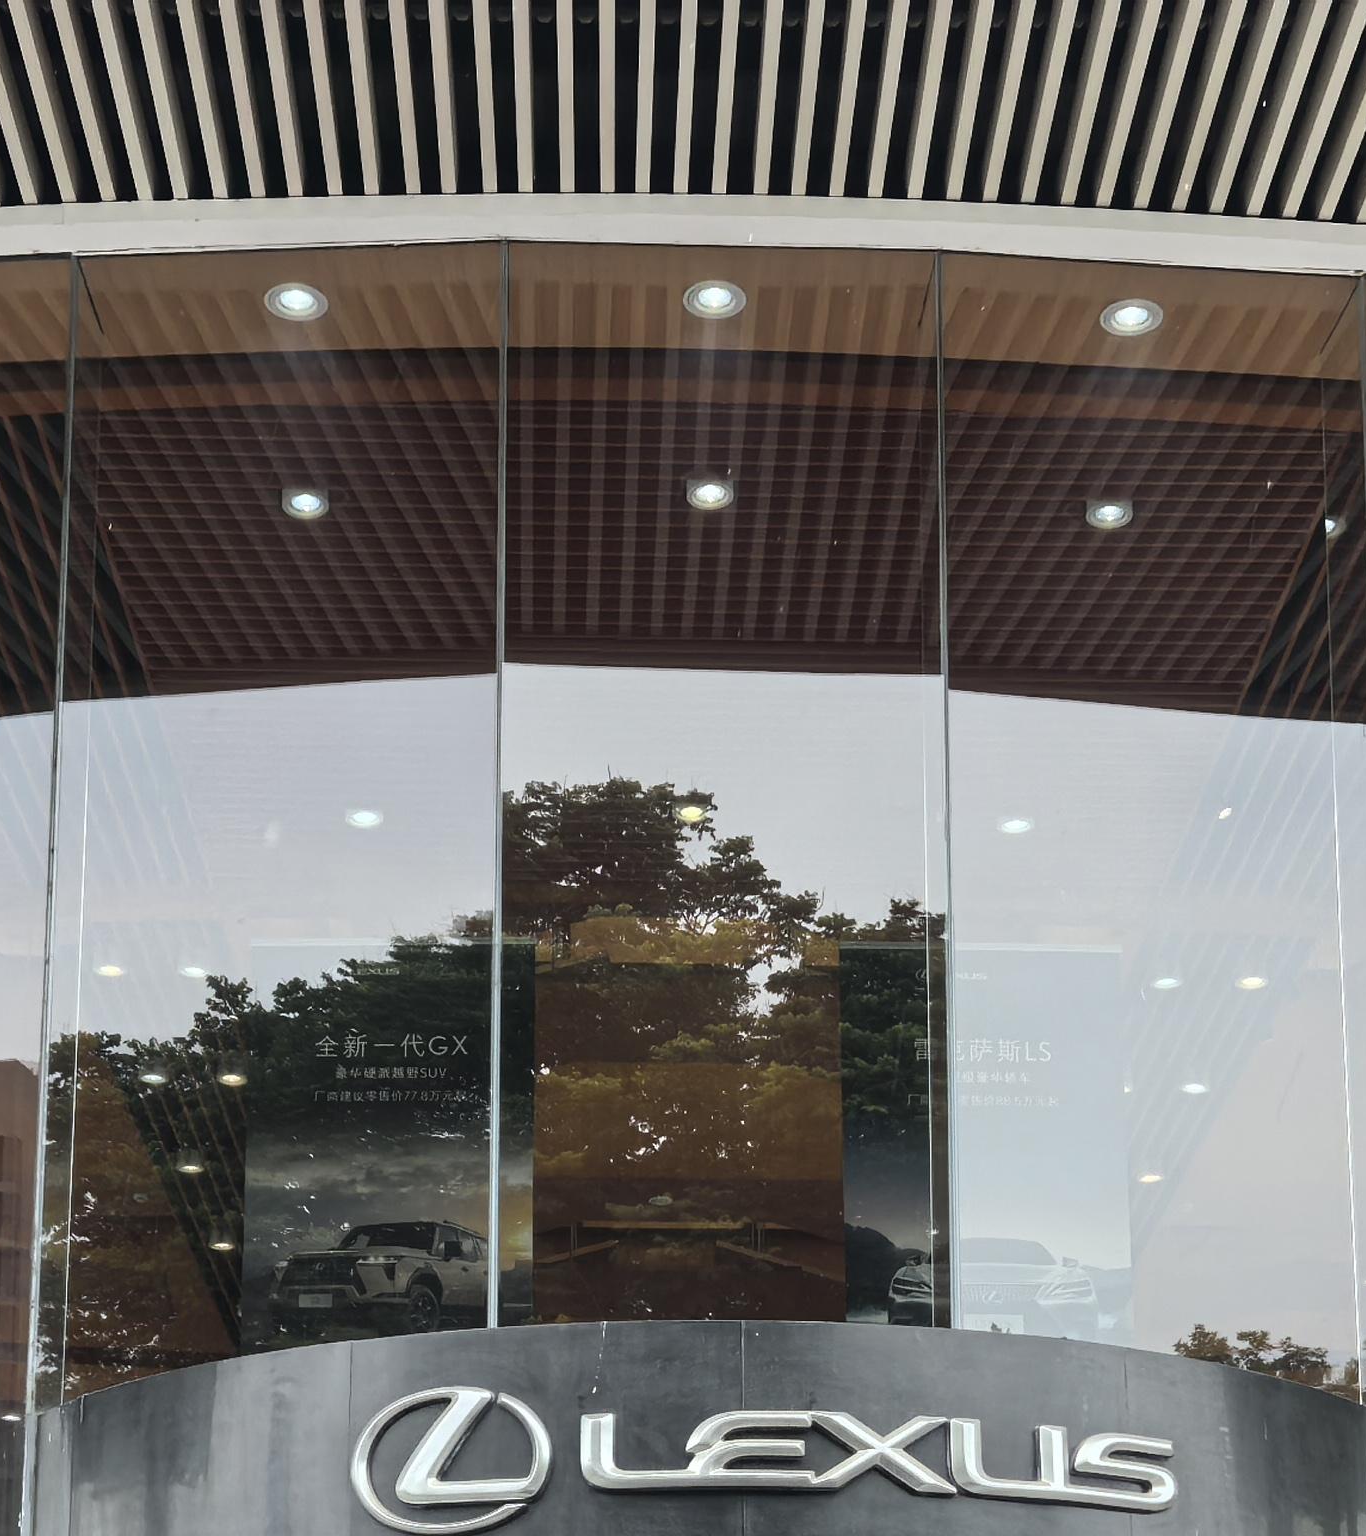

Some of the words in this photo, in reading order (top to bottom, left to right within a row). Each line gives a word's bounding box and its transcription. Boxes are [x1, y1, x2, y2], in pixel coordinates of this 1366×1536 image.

[314, 1033, 469, 1059] 全新一代GX
[580, 1409, 1178, 1515] LEXUS
